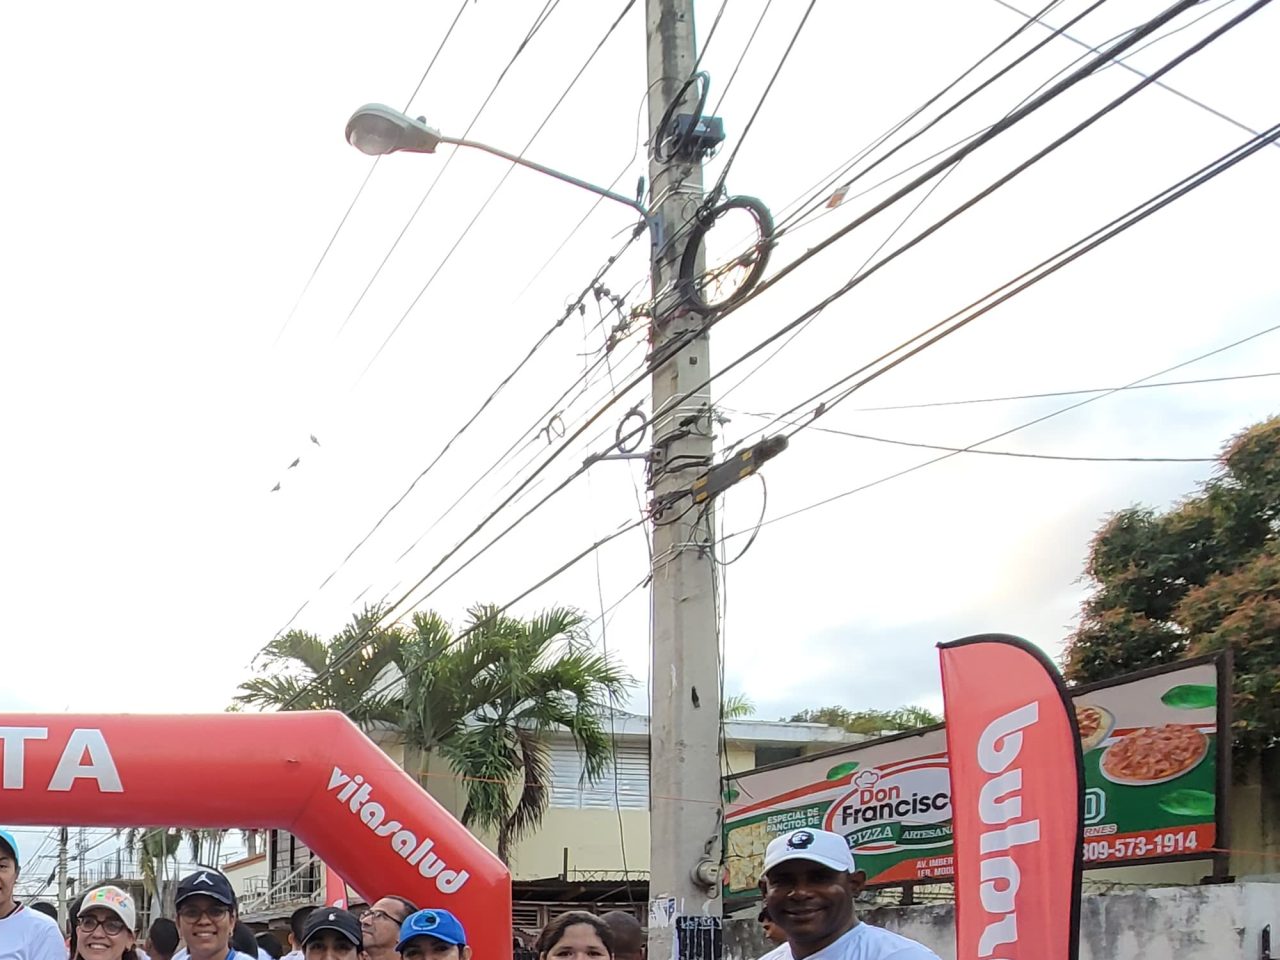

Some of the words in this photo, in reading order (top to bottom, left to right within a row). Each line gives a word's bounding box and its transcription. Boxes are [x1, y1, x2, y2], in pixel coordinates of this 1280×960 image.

[860, 785, 901, 805] Don
[767, 810, 806, 825] ESPECIAL
[807, 807, 820, 817] DE
[842, 792, 951, 826] Francisc
[327, 766, 470, 894] vitasalud
[767, 818, 807, 832] PANCITOS
[807, 816, 821, 826] DE
[1085, 825, 1116, 836] RNES
[847, 826, 893, 847] PIZZA
[929, 857, 954, 867] IMBER
